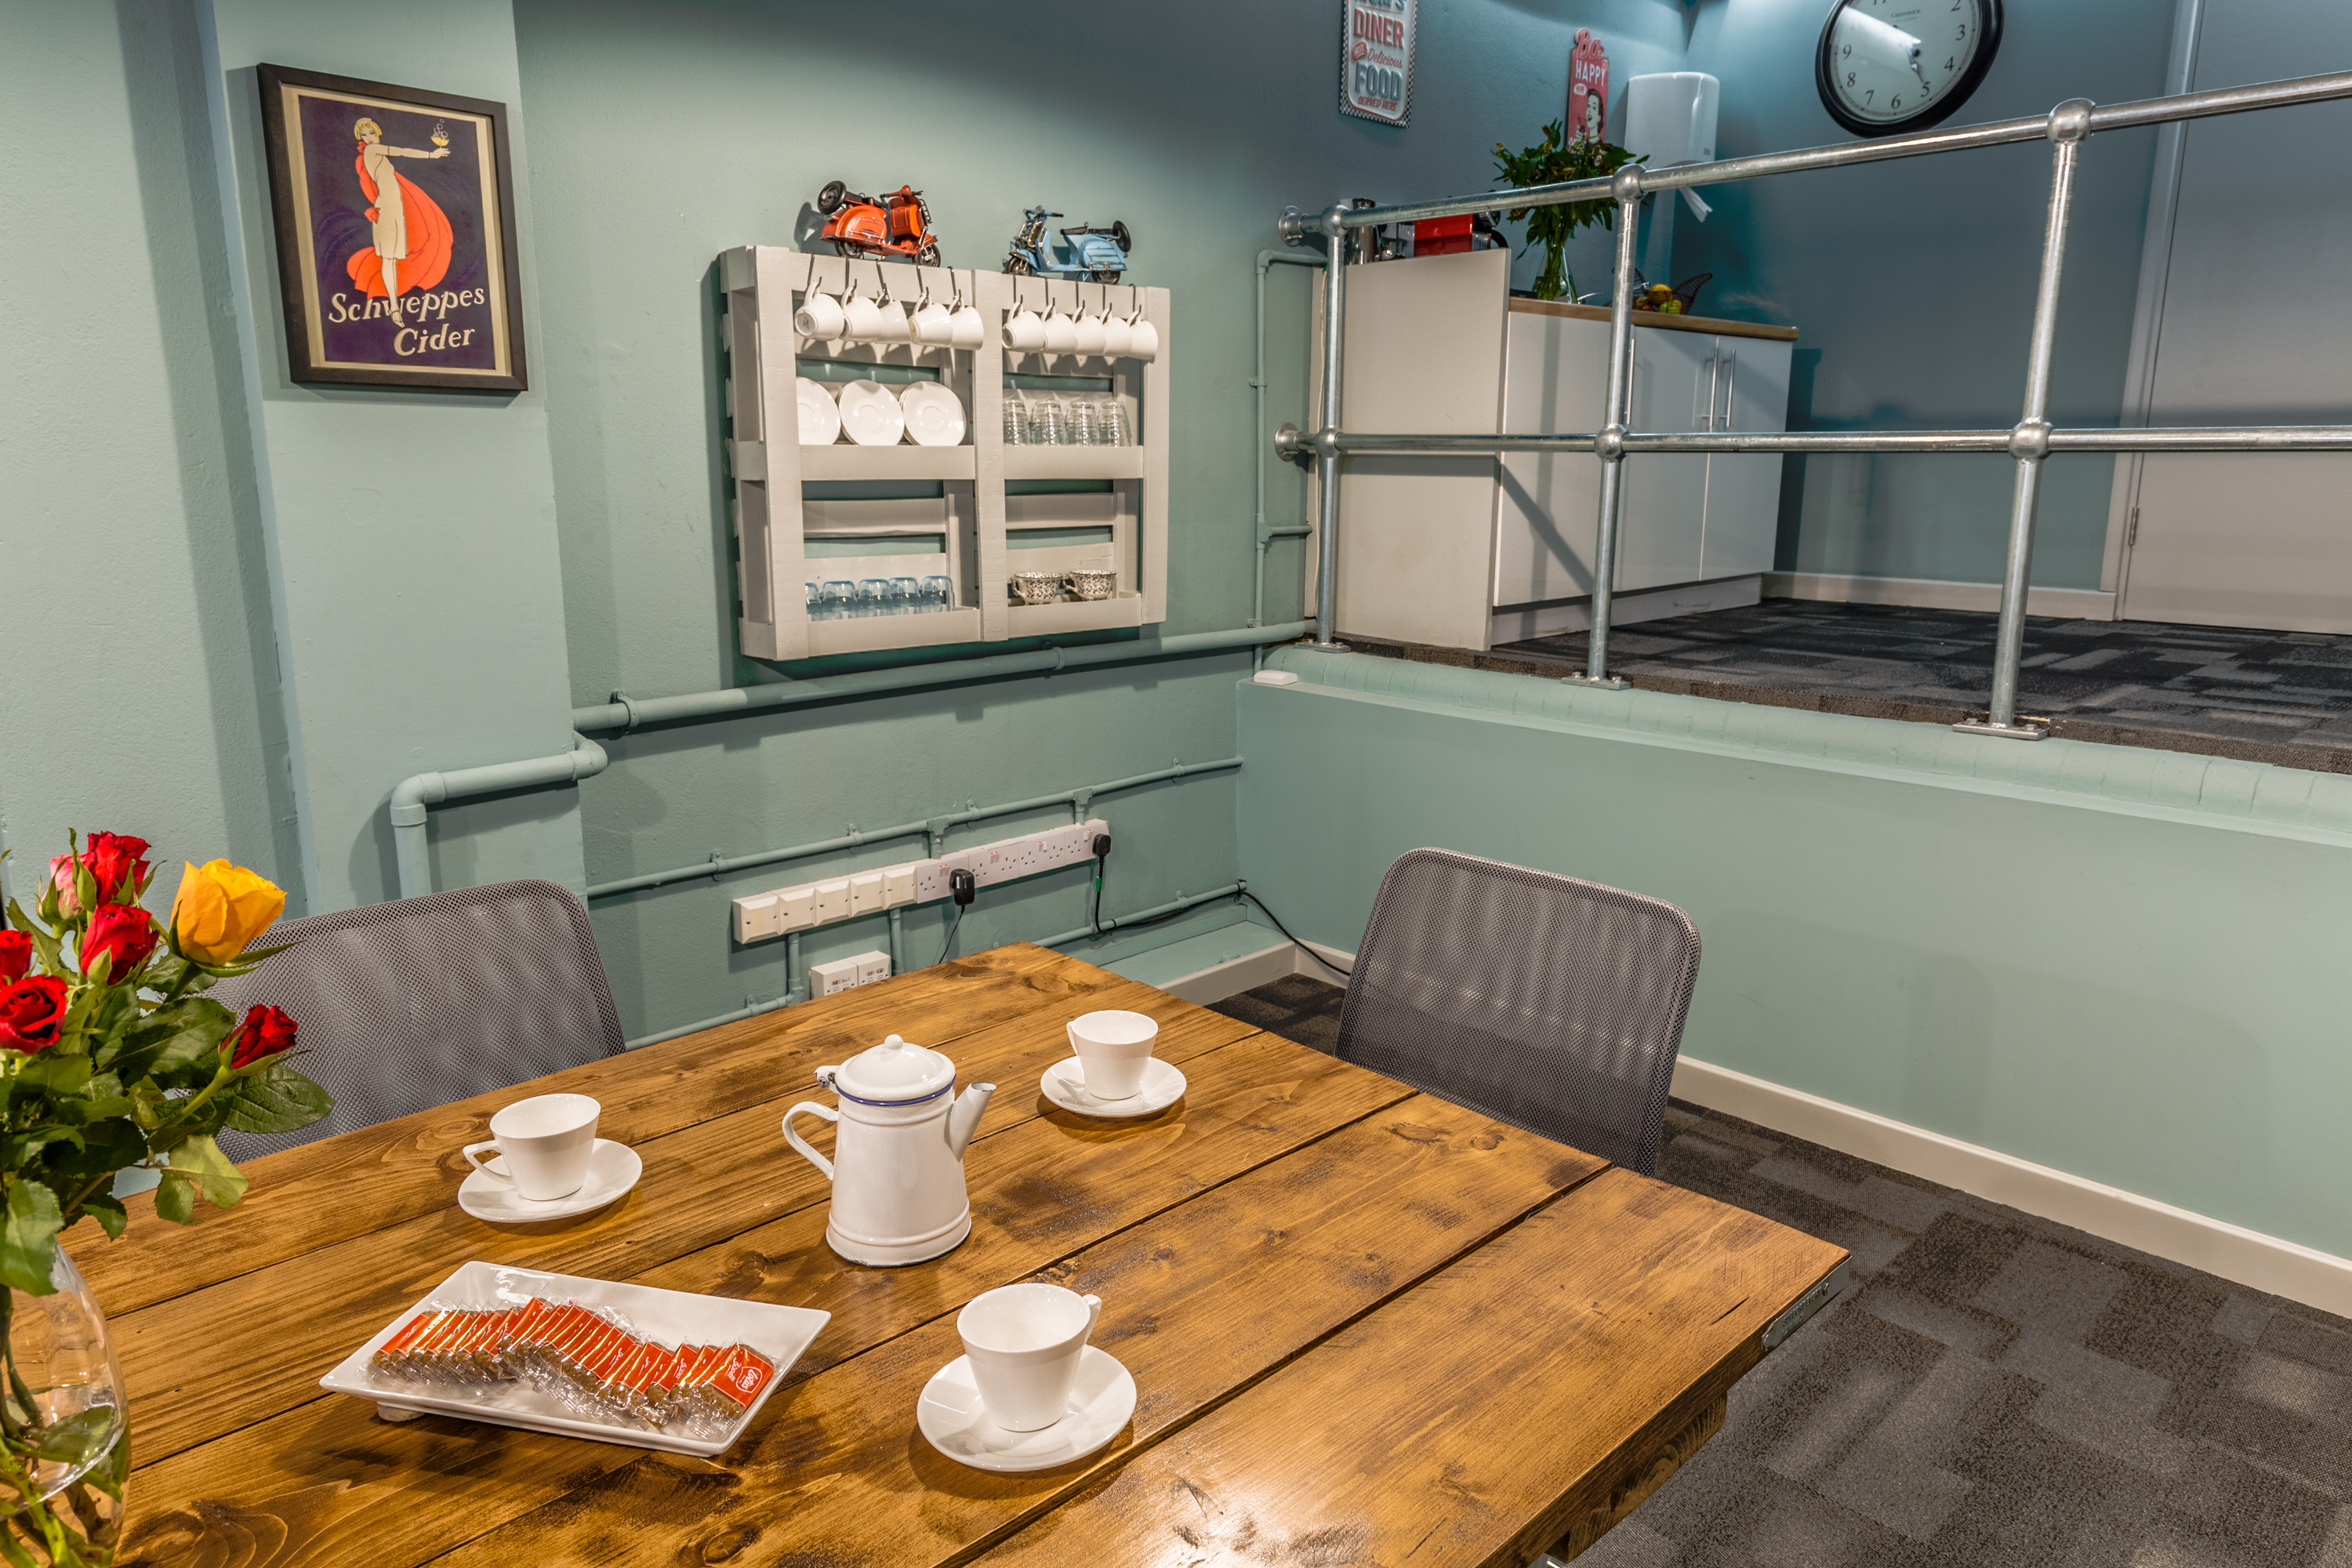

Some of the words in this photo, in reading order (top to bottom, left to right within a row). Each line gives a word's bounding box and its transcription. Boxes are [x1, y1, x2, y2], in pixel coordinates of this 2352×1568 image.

[1354, 8, 1404, 49] DINER
[1955, 24, 1965, 41] 3
[1367, 48, 1403, 68] Delicious
[1842, 44, 1852, 60] 9
[1944, 56, 1955, 71] 4
[1355, 61, 1403, 101] FOOD
[1575, 59, 1606, 87] HAPPY
[1846, 71, 1856, 87] 8
[1865, 89, 1875, 106] 7
[1921, 82, 1931, 97] 5
[1357, 96, 1381, 108] SERVED
[1381, 100, 1398, 111] HERE
[1891, 93, 1901, 109] 6
[328, 288, 485, 323] Schweppes
[394, 323, 475, 356] Cider
[728, 1357, 742, 1382] Biscoff
[741, 1369, 758, 1389] Lotus
